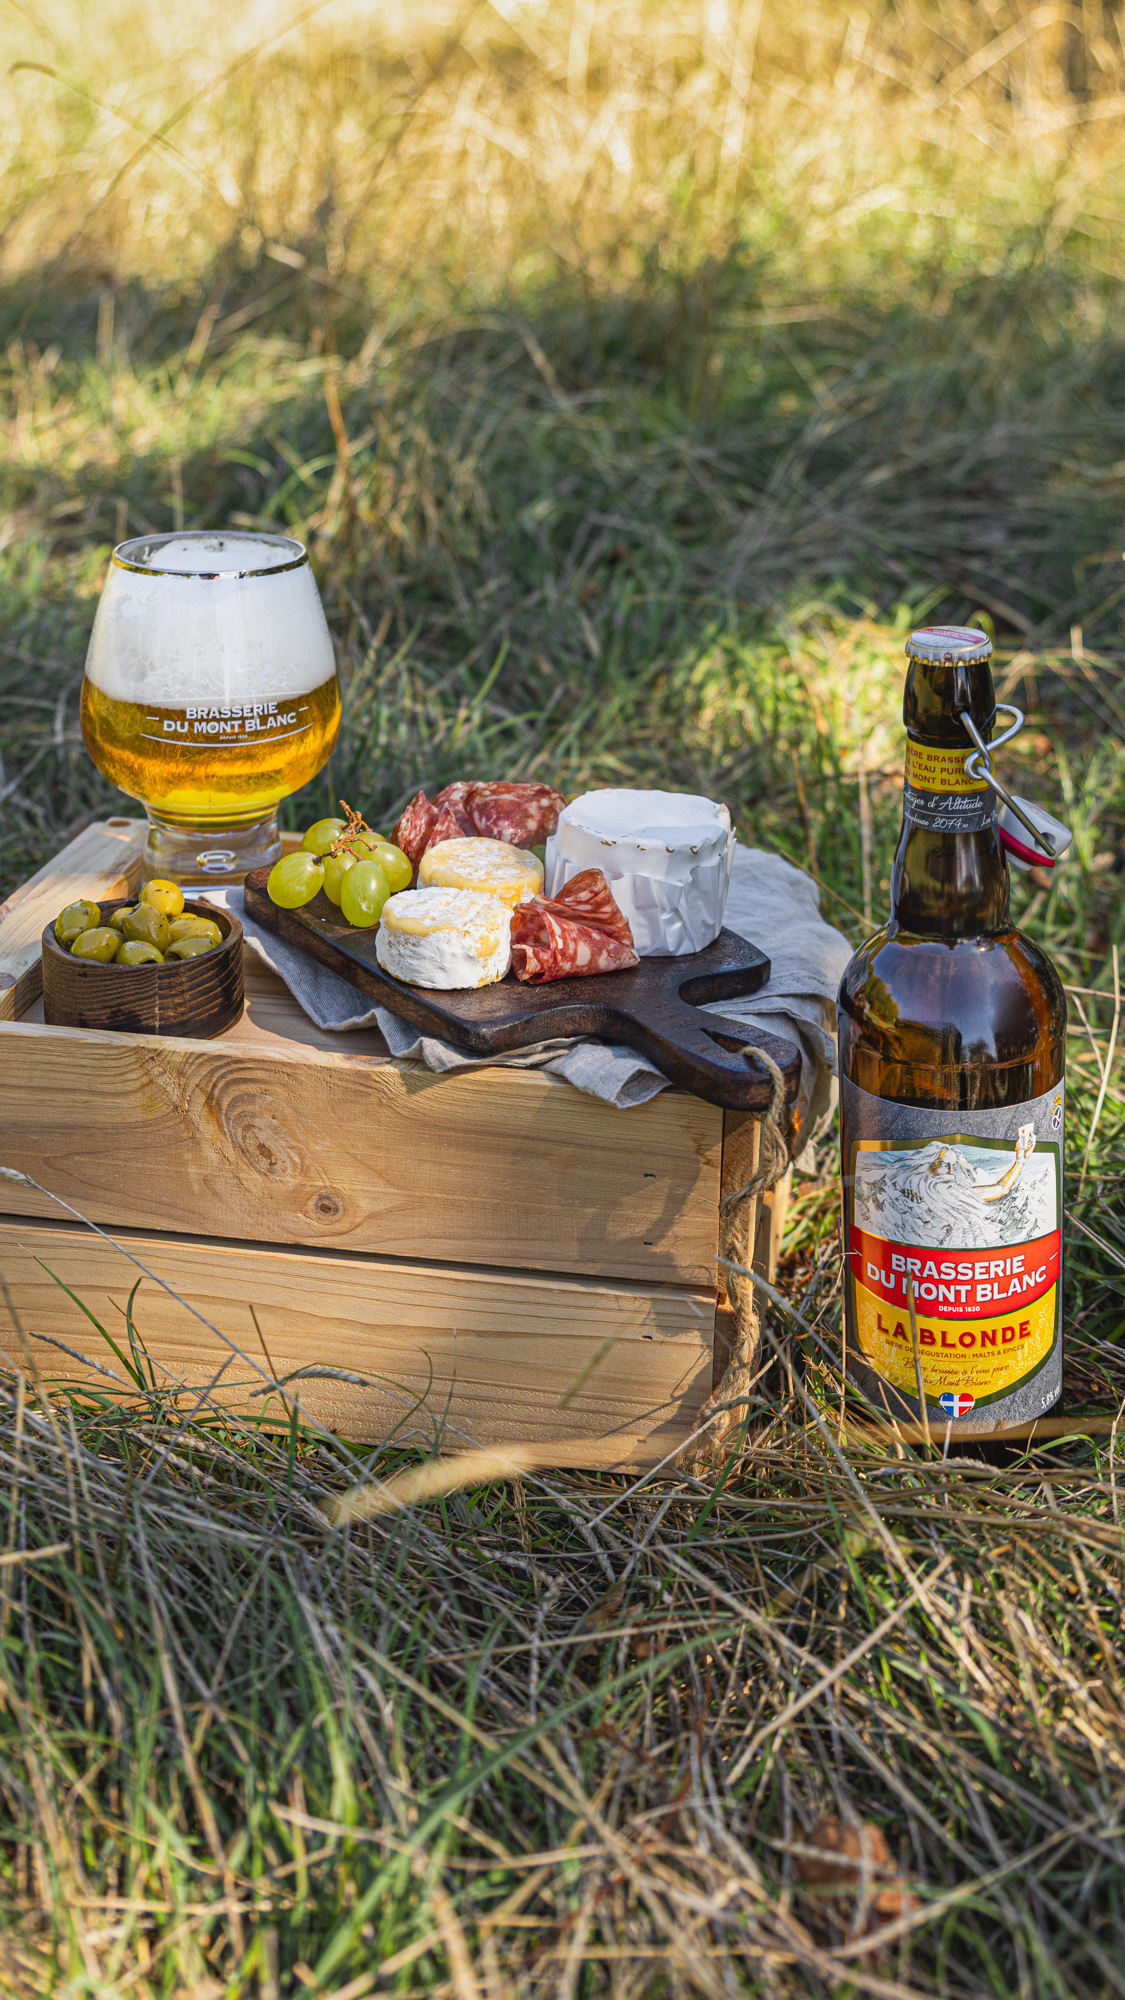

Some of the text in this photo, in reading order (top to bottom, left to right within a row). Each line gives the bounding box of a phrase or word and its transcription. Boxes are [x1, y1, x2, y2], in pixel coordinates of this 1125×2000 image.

[186, 702, 278, 720] BRASSERIE
[163, 712, 297, 734] DU MONT BLANC
[912, 760, 936, 773] L'EAU
[926, 753, 967, 764] BRASSÉ
[912, 772, 936, 784] MONT
[940, 778, 974, 786] BLANC
[891, 1252, 1025, 1281] BRASSERIE
[866, 1261, 1047, 1303] DU MONT BLANC
[938, 1305, 980, 1313] DEPUIS 1830
[876, 1313, 1031, 1349] LA BLONDE
[885, 1338, 904, 1351] BIÈRE
[972, 1351, 996, 1359] MALTS
[1002, 1343, 1025, 1355] ÉPICES
